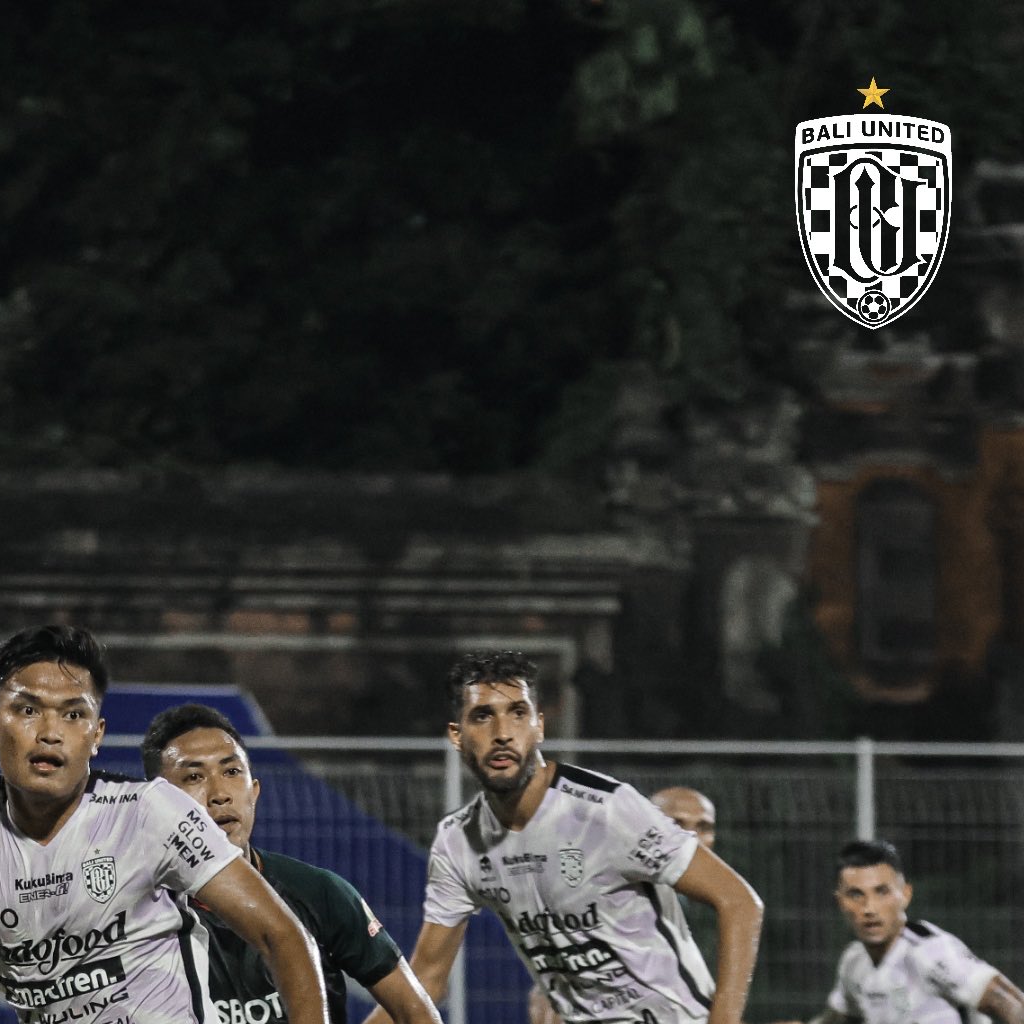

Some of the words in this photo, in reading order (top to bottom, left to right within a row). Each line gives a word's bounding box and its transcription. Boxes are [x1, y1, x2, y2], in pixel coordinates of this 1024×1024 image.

[119, 793, 138, 803] INA
[186, 808, 208, 832] MS
[171, 834, 200, 868] MEN
[178, 821, 215, 861] GLOW
[15, 871, 73, 891] KukuBima
